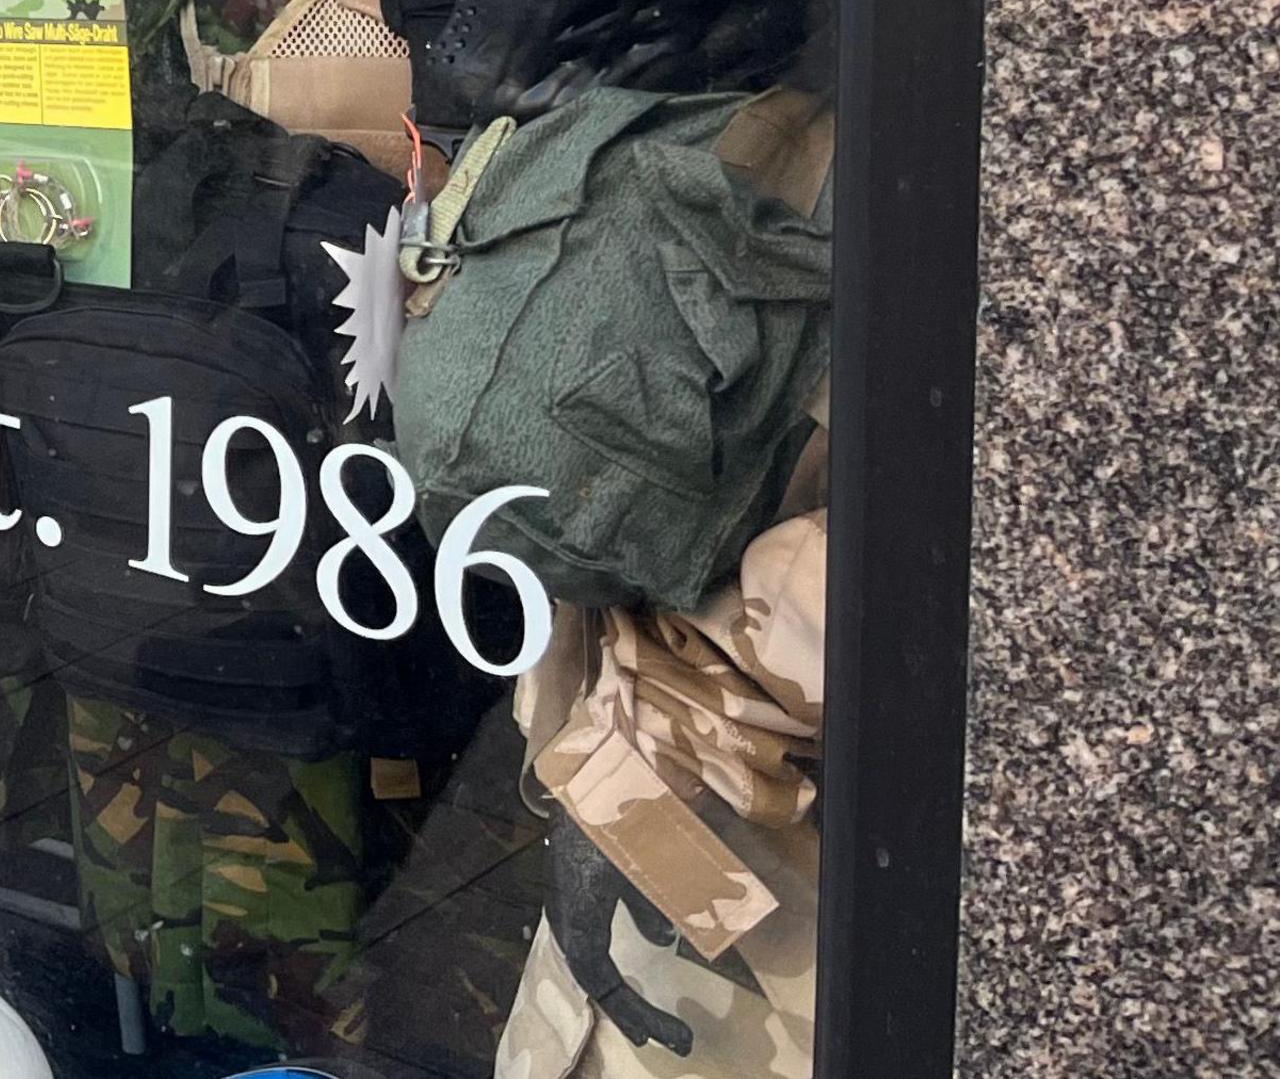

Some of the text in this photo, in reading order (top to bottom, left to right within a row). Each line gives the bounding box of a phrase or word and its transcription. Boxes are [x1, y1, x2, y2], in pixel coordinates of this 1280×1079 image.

[3, 22, 24, 41] Wire
[25, 22, 44, 42] Saw
[126, 395, 554, 678] 1986
